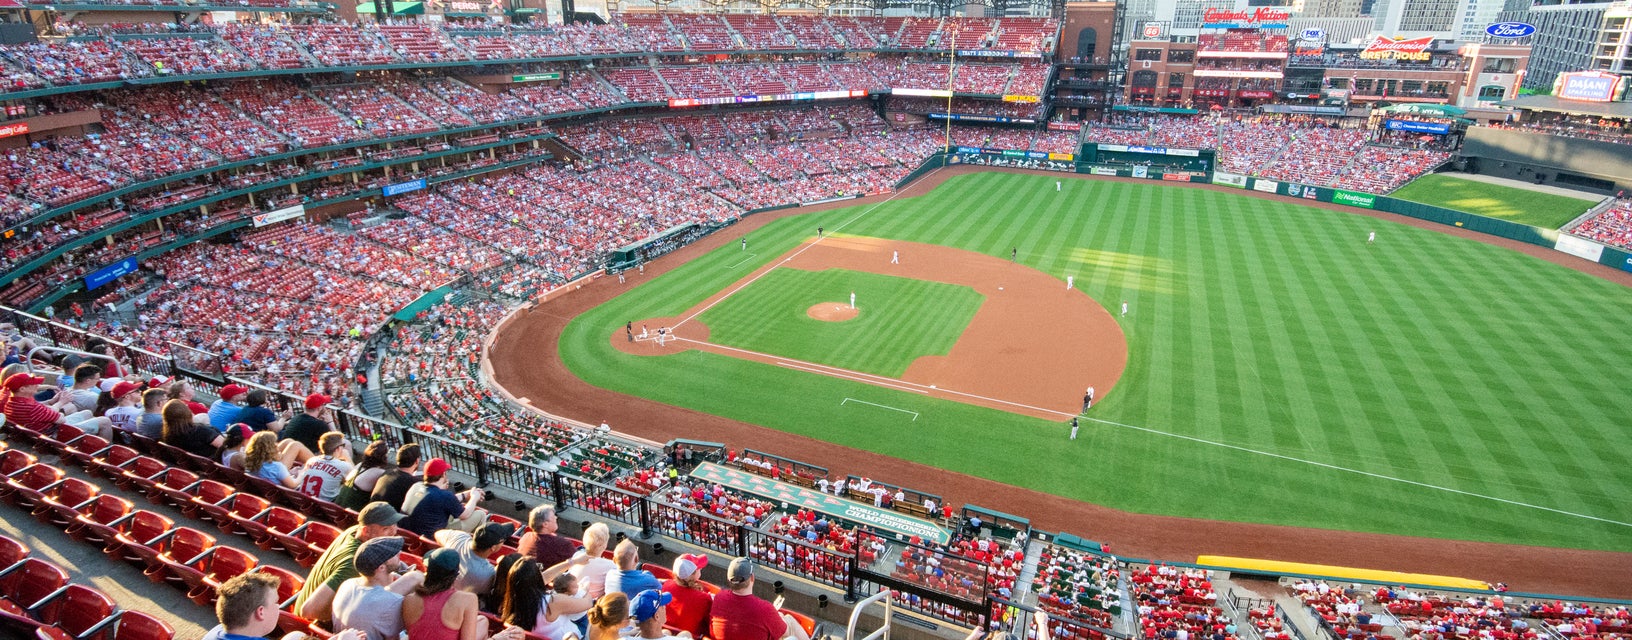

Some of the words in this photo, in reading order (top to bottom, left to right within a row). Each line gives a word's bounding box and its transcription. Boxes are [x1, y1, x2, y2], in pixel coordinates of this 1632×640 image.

[1204, 7, 1248, 23] Cardinals
[1248, 7, 1289, 23] Nation
[1495, 24, 1526, 35] Ford
[1370, 40, 1432, 49] Budweiser
[1360, 51, 1389, 59] BREW
[1393, 52, 1431, 60] HOUSE
[1570, 79, 1607, 90] DASANI
[1343, 194, 1374, 203] National
[301, 475, 323, 497] 13
[848, 505, 879, 517] WORLD
